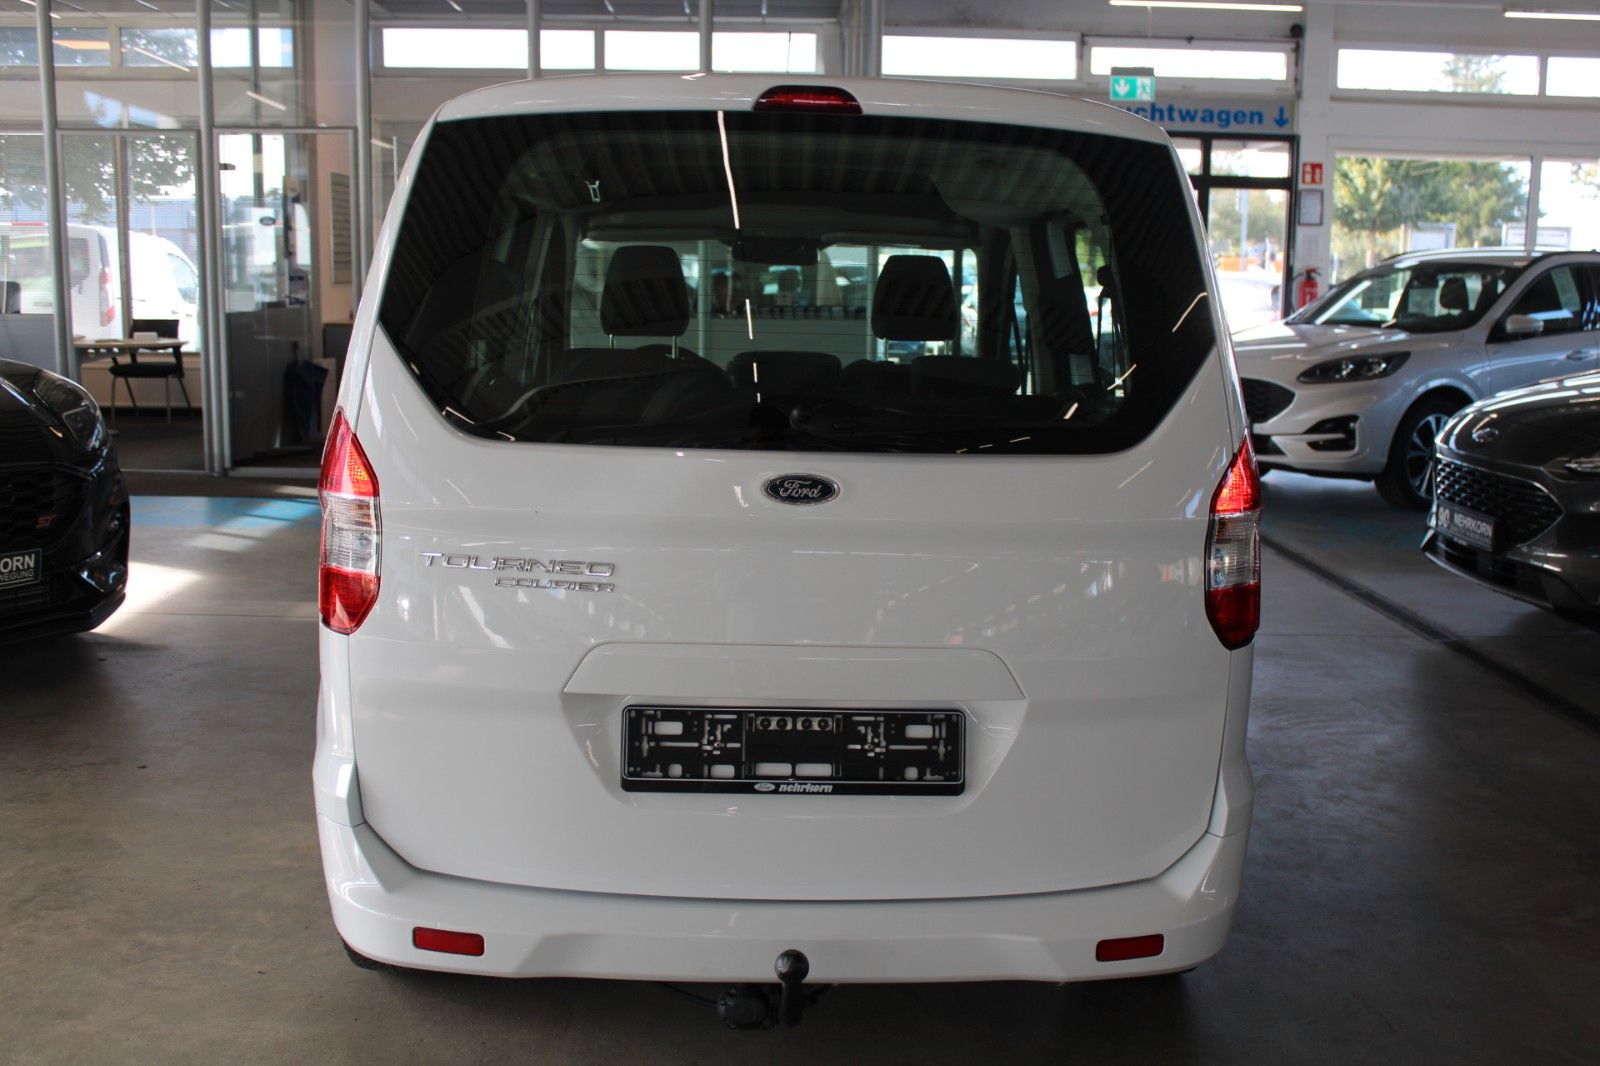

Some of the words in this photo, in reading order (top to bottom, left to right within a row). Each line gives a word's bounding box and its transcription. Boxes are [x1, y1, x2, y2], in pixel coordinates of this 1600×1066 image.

[1126, 102, 1263, 128] chtwagen
[780, 479, 822, 498] Ford
[0, 554, 36, 573] ORN
[417, 552, 615, 577] TOURNEO
[495, 577, 615, 592] COURIER
[779, 783, 833, 793] nehrkorn
